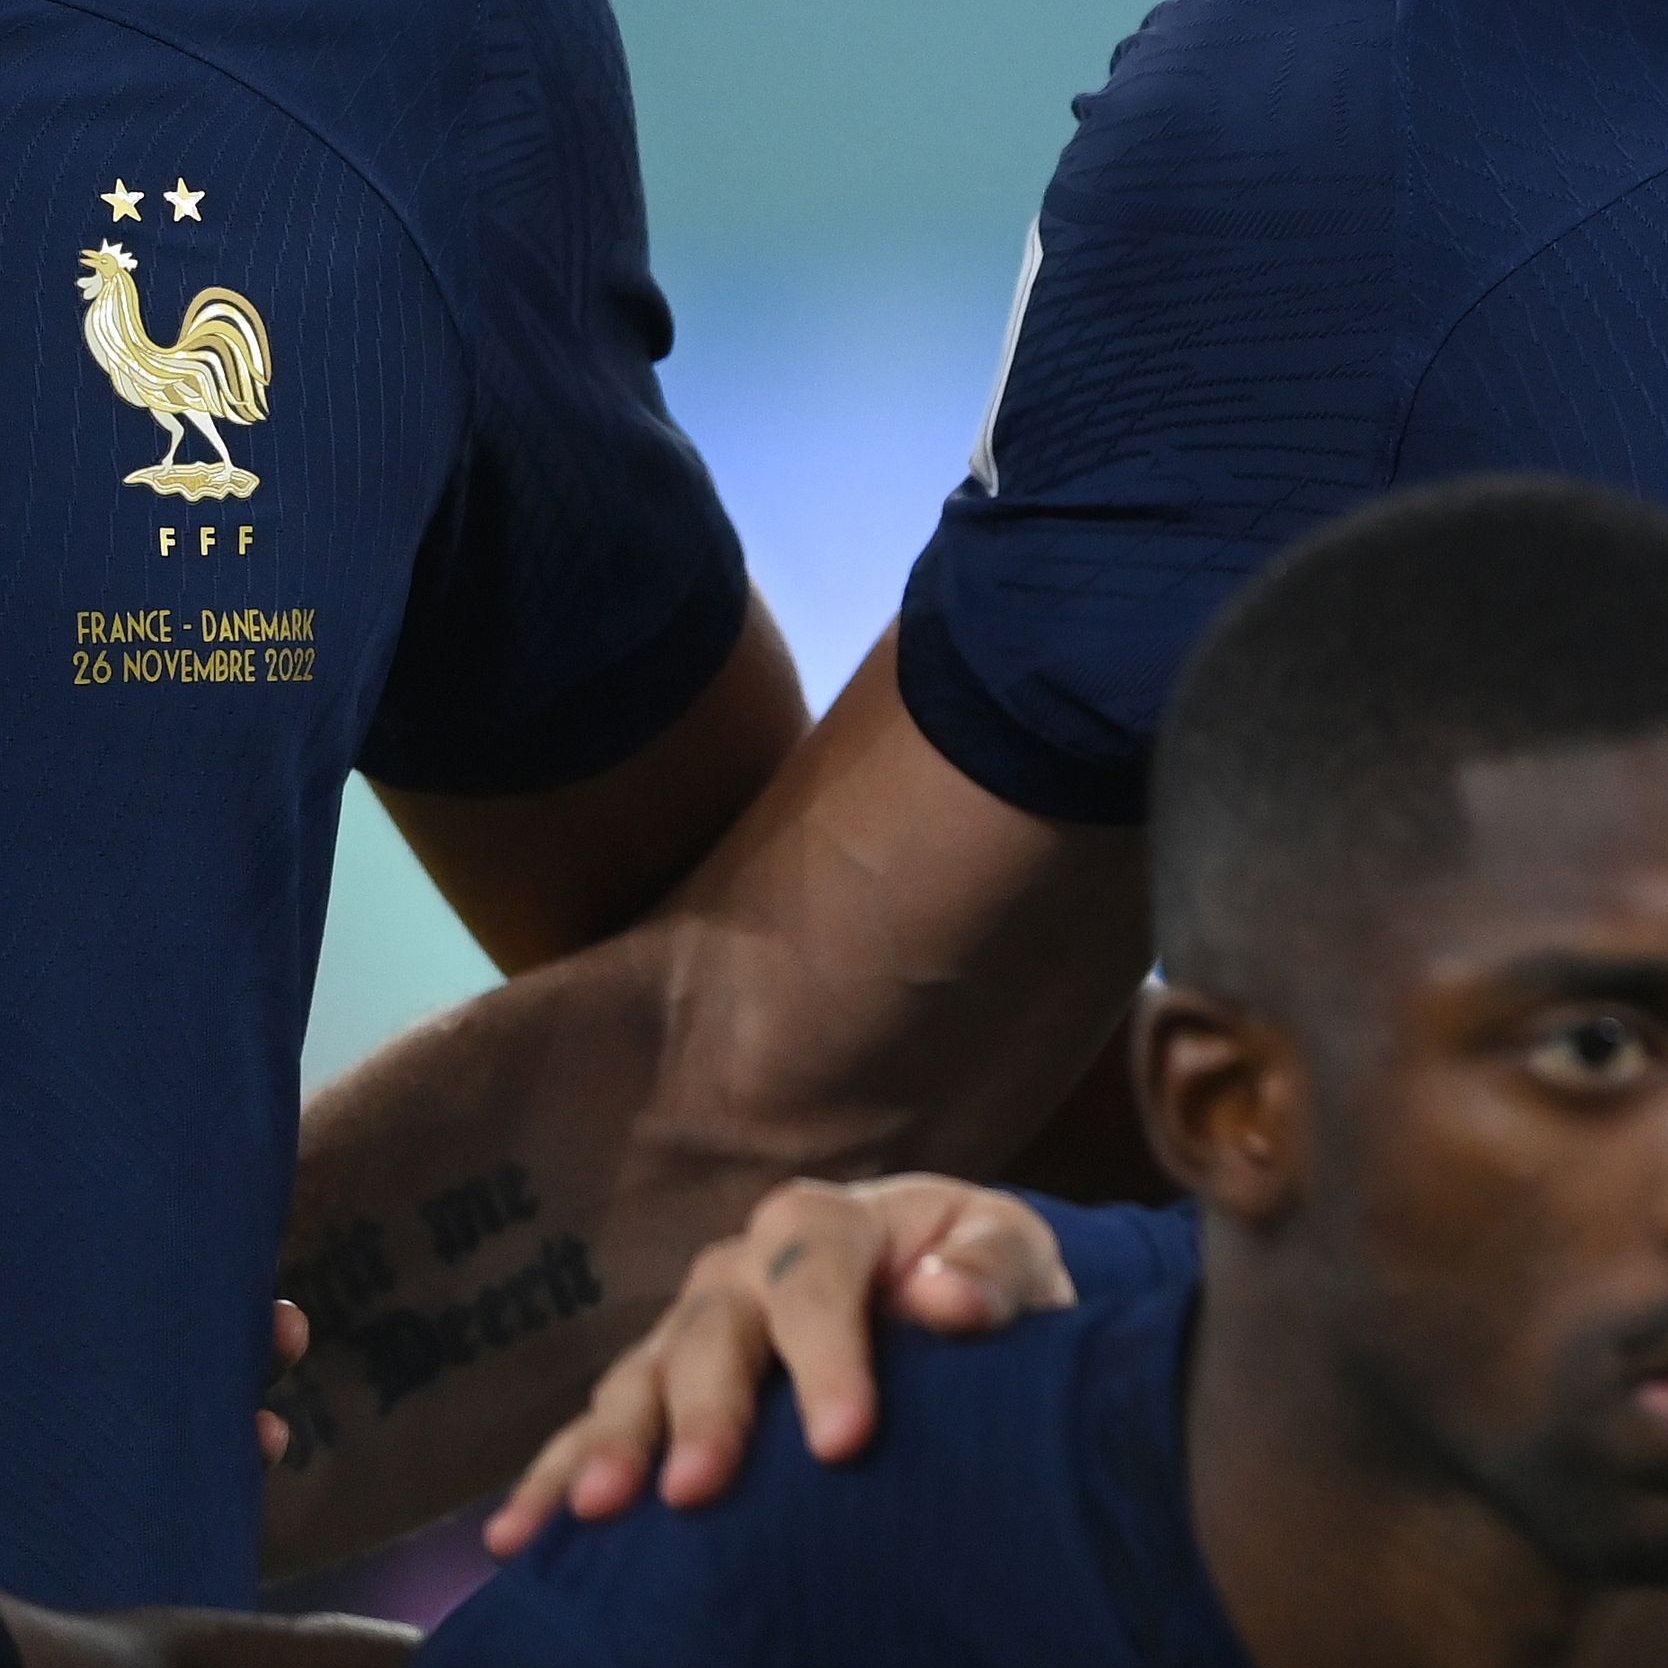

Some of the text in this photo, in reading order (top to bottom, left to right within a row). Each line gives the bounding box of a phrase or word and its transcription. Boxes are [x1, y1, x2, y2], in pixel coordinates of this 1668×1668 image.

[76, 609, 172, 644] FRANCE
[201, 608, 315, 643] DANEMARK
[72, 647, 316, 685] 26 NOVEMBRE 2022
